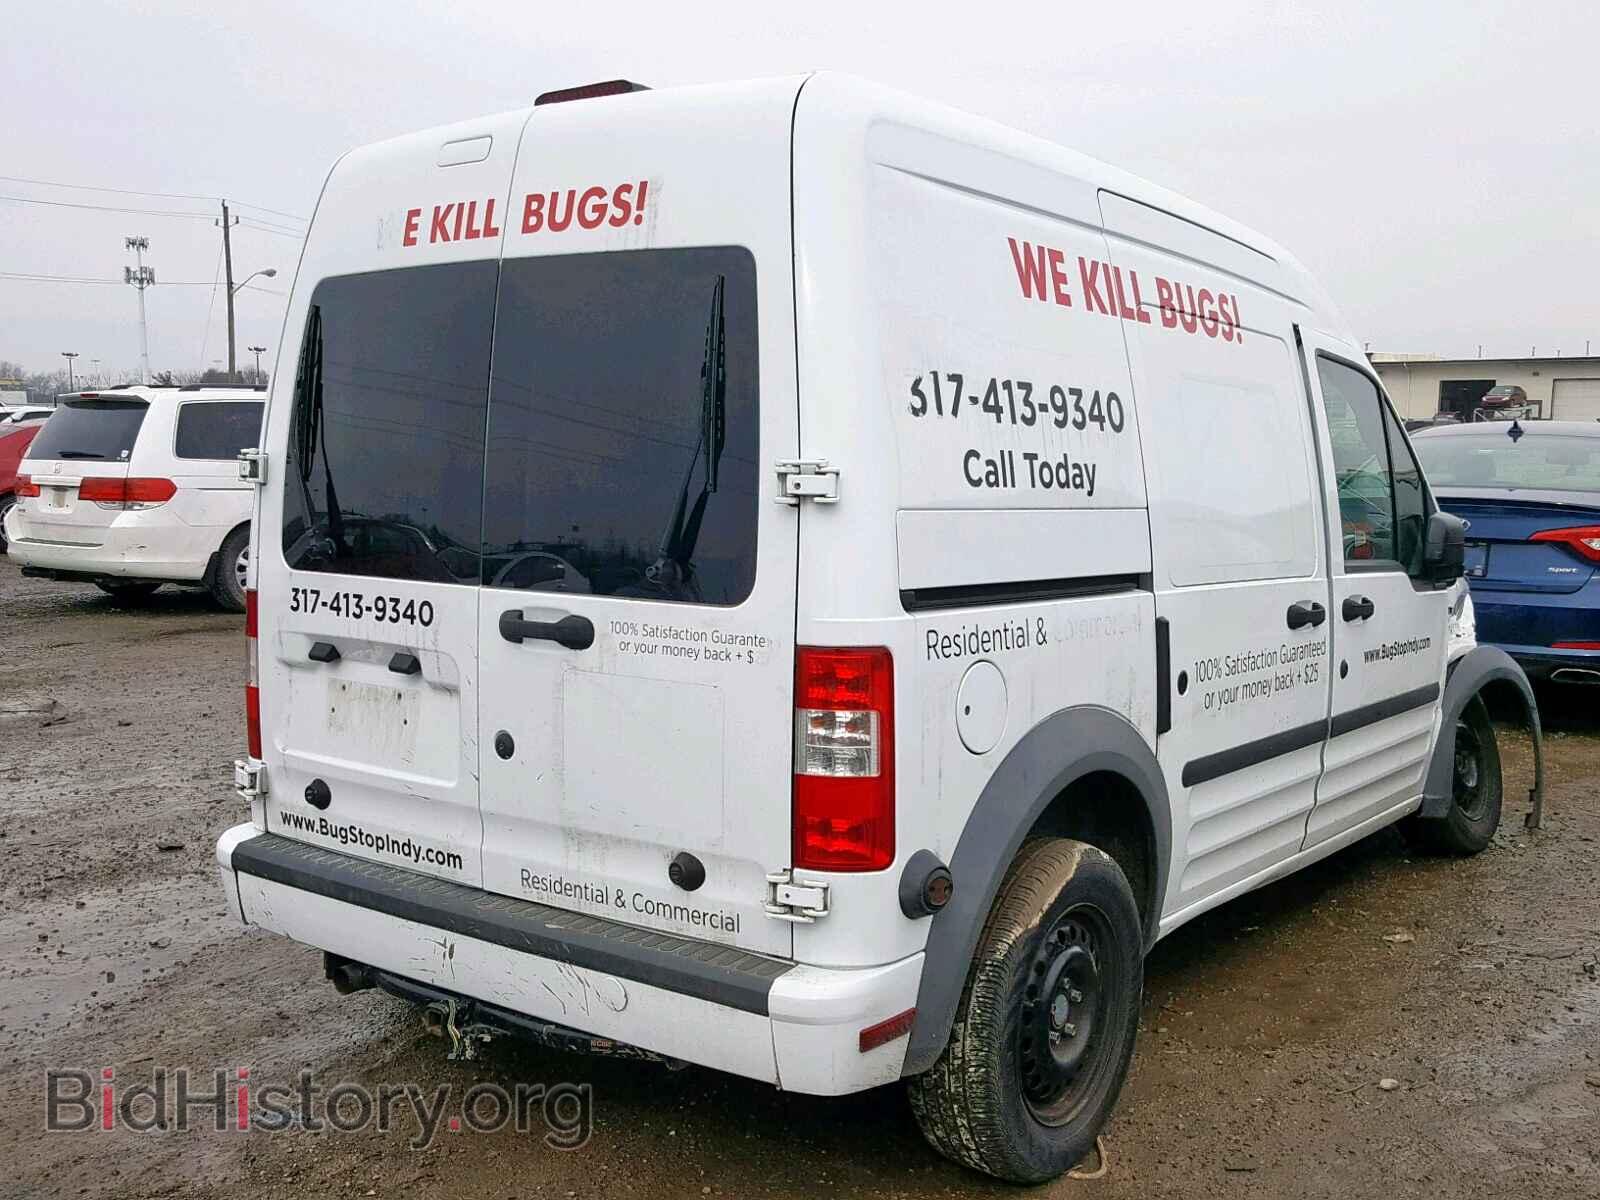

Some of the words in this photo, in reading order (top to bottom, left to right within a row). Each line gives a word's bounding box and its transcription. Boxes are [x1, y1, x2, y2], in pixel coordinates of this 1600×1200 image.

[430, 199, 499, 243] KILL
[521, 181, 649, 234] BUGS!
[1008, 237, 1072, 307] WE
[1078, 256, 1151, 324] KILL
[1155, 277, 1243, 344] BUGS!
[909, 371, 1124, 433] 317-413-9340
[963, 449, 1016, 488] Call
[1023, 452, 1096, 496] Today
[290, 587, 434, 627] 317-413-9340
[610, 620, 638, 637] 100%
[642, 623, 708, 642] Satisfaction
[619, 640, 630, 651] or
[634, 641, 658, 655] your
[662, 644, 700, 661] money
[704, 646, 732, 662] back
[926, 617, 1030, 661] Residential
[1036, 616, 1048, 646] &
[1194, 654, 1223, 684] 100%
[1224, 649, 1278, 677] Satisfaction
[1279, 636, 1327, 665] Guaranteed
[1204, 692, 1215, 710] or
[1218, 688, 1240, 711] your
[1242, 678, 1272, 700] money
[1275, 672, 1295, 692] back
[1304, 662, 1319, 685] $25
[280, 809, 464, 870] www.BugStopIndy.com
[520, 868, 609, 905] Residential
[615, 888, 627, 909] &
[632, 893, 741, 934] Commercial
